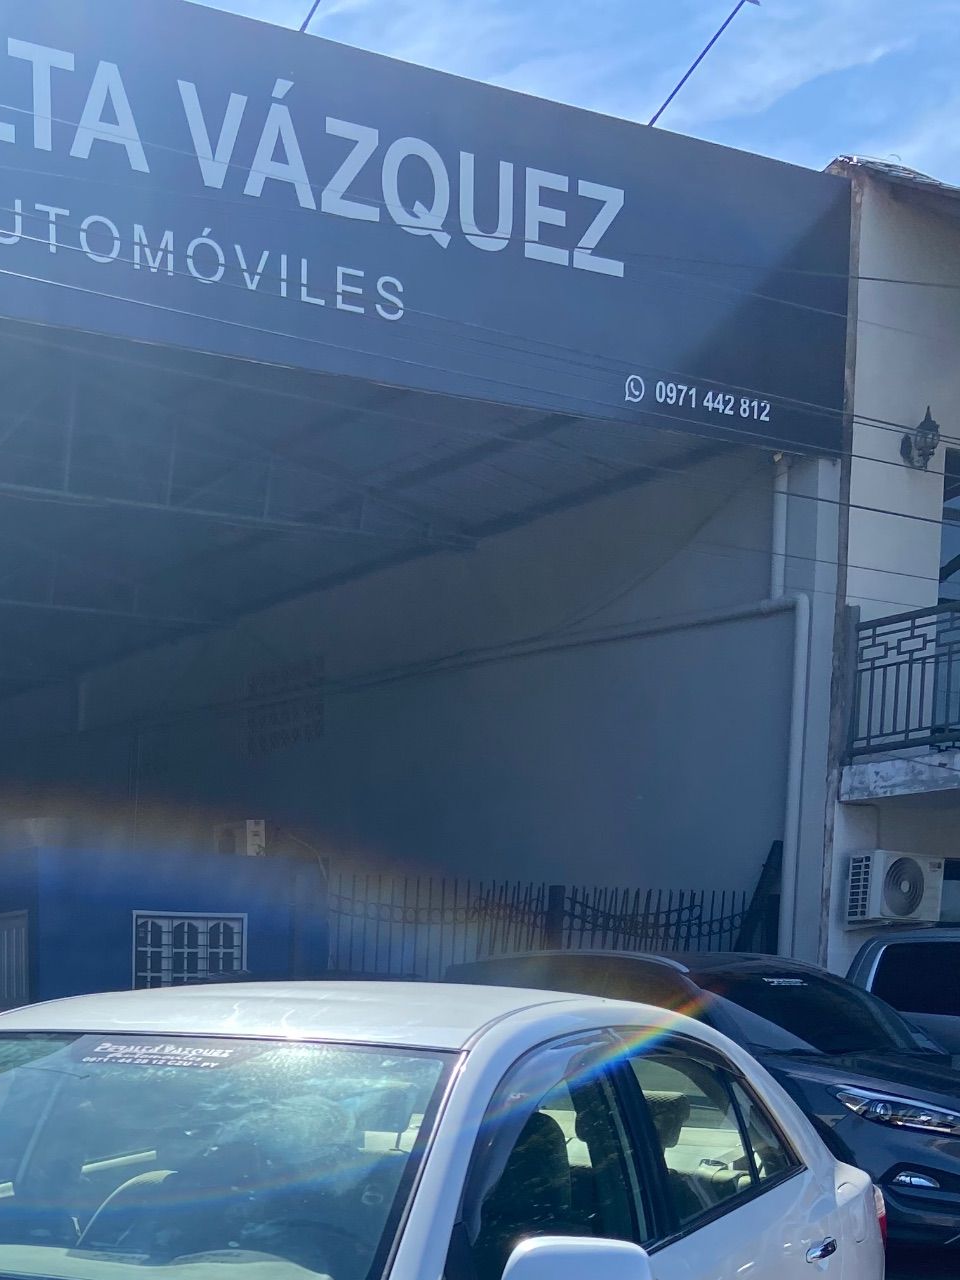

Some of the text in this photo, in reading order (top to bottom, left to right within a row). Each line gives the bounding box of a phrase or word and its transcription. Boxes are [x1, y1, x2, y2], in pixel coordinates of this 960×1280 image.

[177, 78, 625, 278] VÁZQUEZ
[655, 380, 771, 422] 0971 442 812
